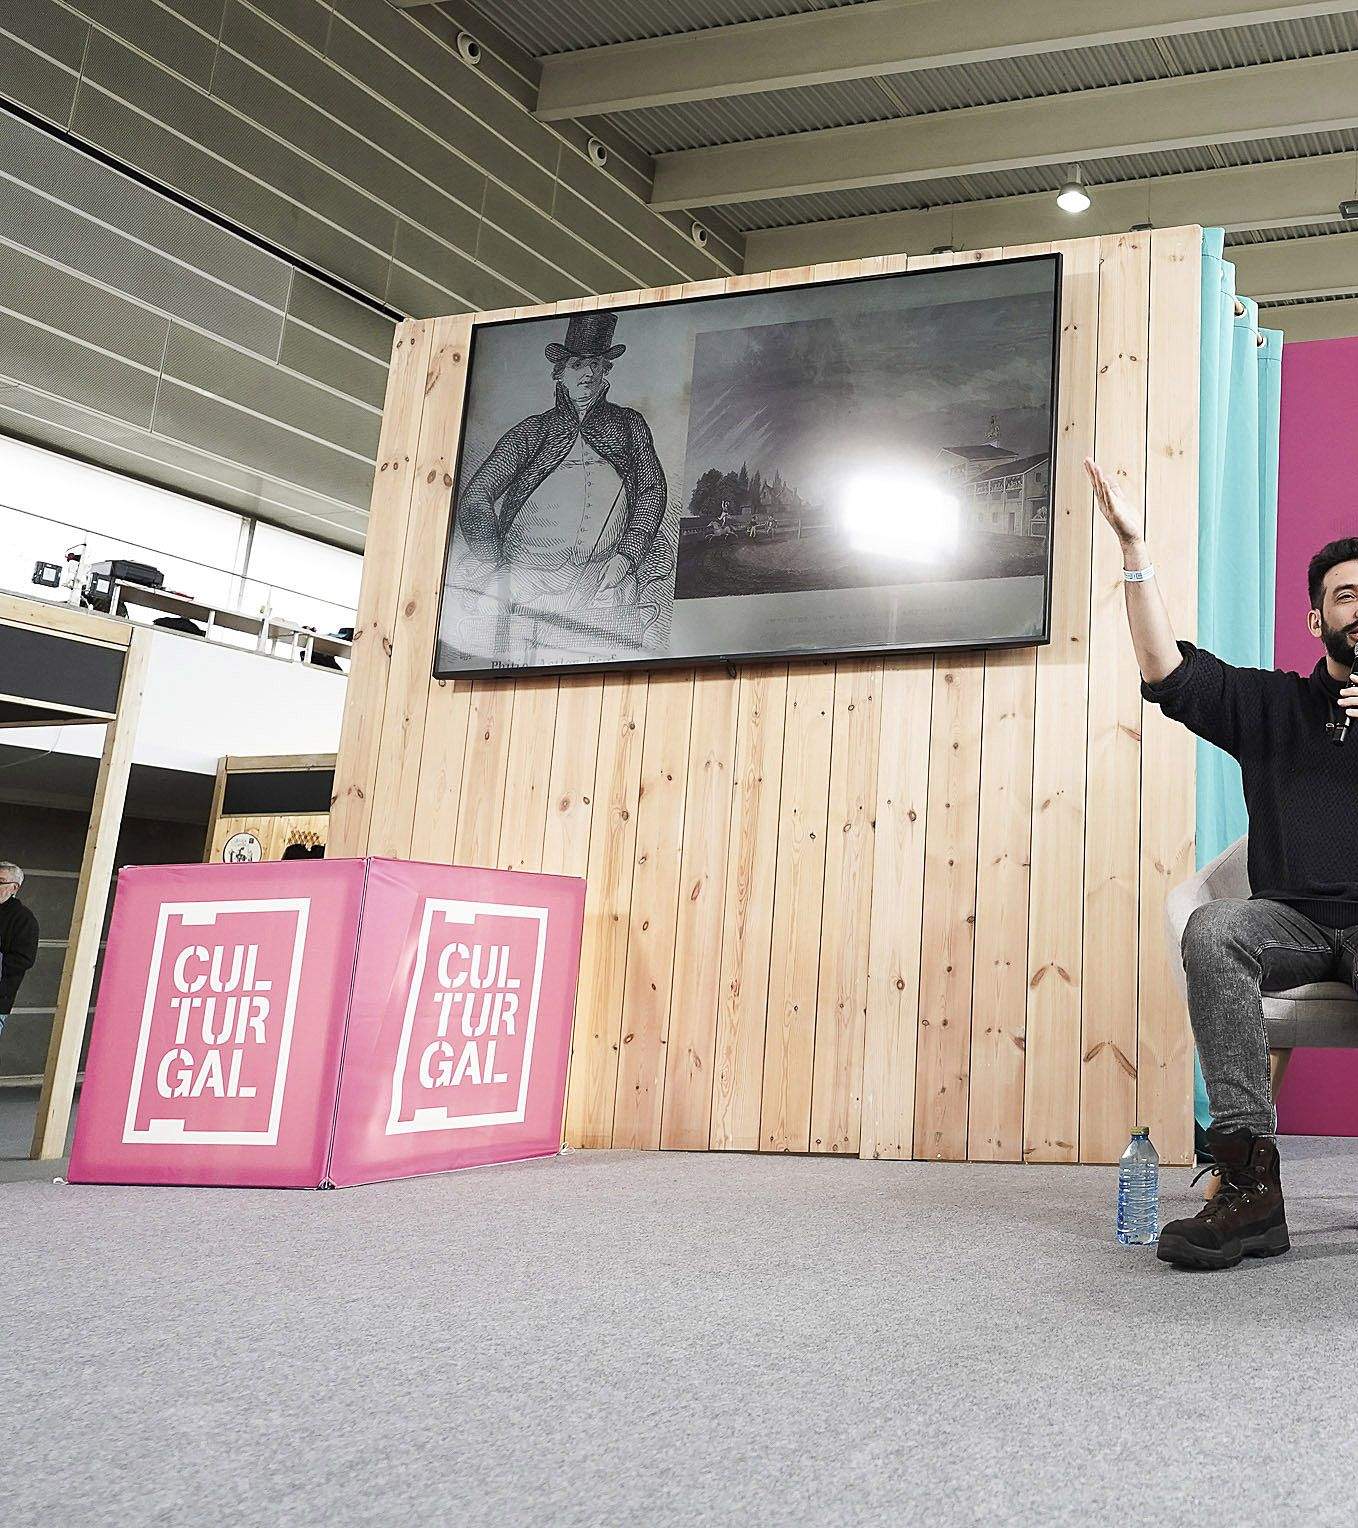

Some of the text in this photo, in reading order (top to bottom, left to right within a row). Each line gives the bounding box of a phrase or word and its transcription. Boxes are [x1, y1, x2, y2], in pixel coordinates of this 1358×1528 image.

[173, 944, 273, 993] CUL
[437, 942, 521, 989] CUL
[169, 996, 270, 1045] TUR
[433, 992, 519, 1037] TUR
[156, 1048, 257, 1098] GAL
[418, 1040, 508, 1089] GAL
